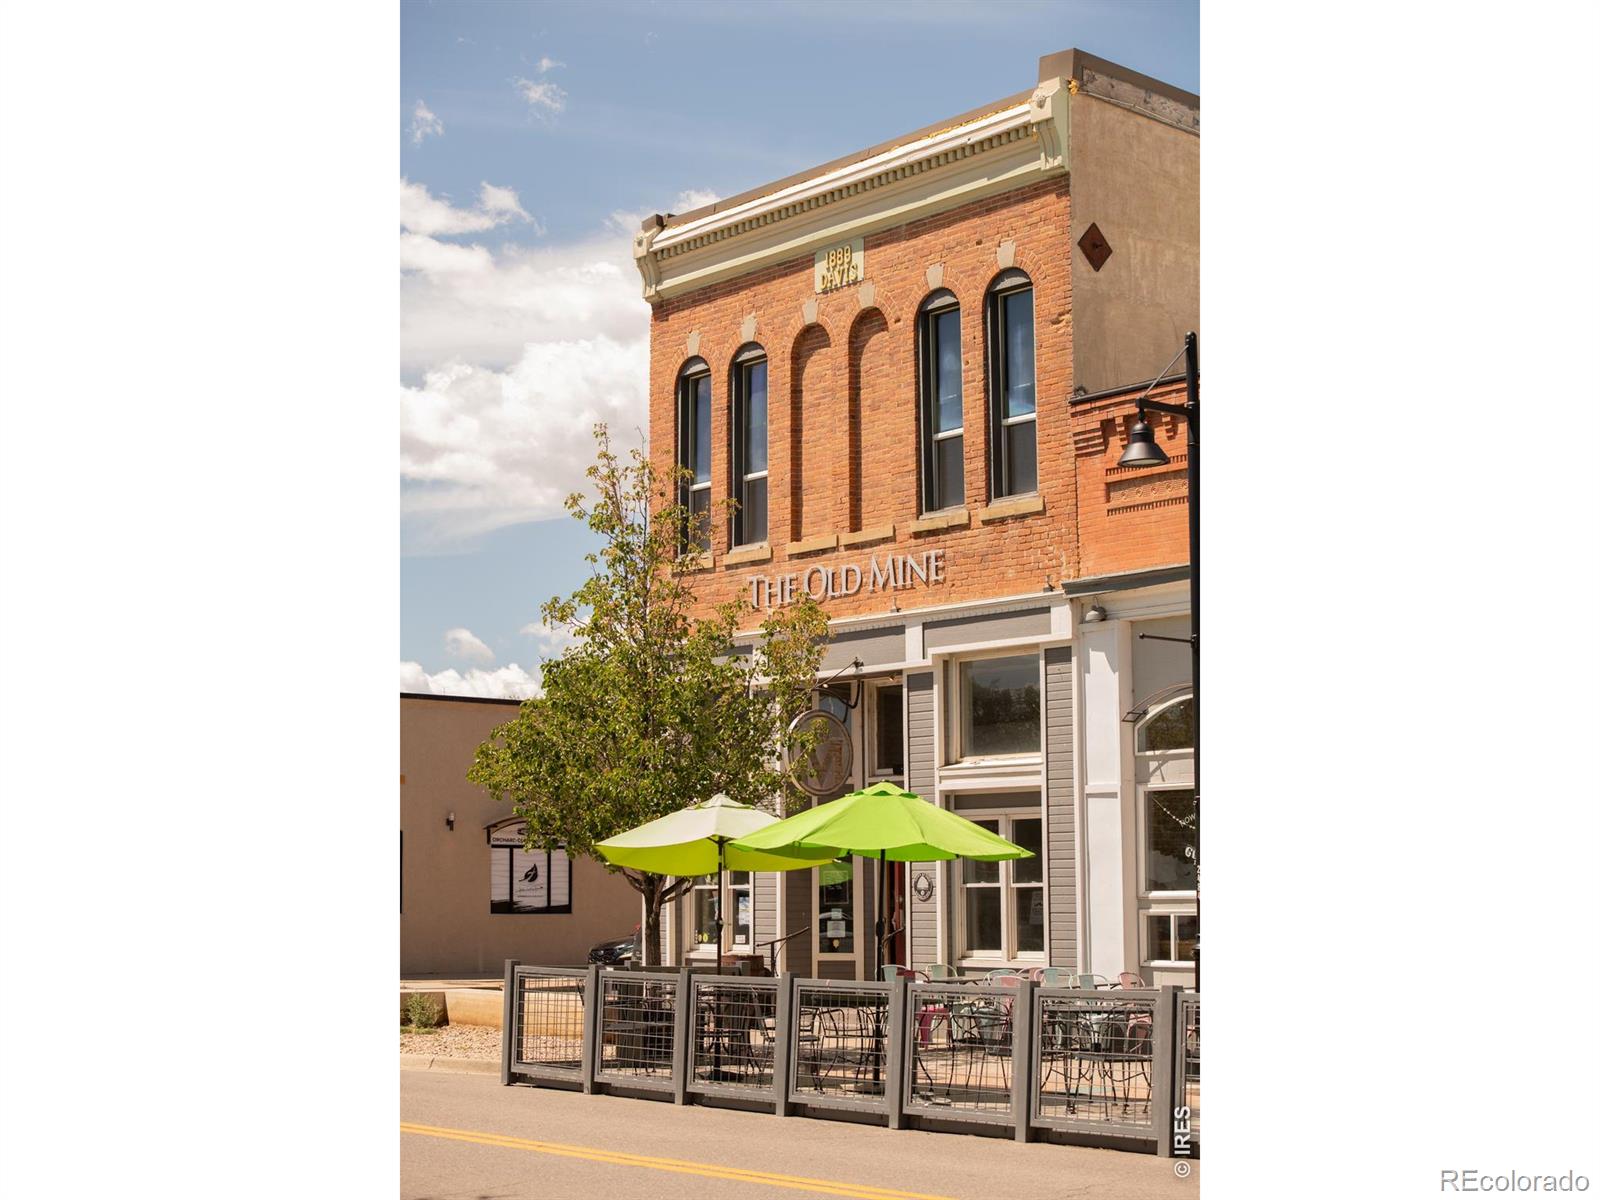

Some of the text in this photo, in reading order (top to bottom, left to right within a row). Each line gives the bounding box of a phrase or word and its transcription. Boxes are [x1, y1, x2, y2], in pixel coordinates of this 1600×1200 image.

[821, 262, 858, 289] DAVIS
[748, 550, 946, 608] THE OLD MINE
